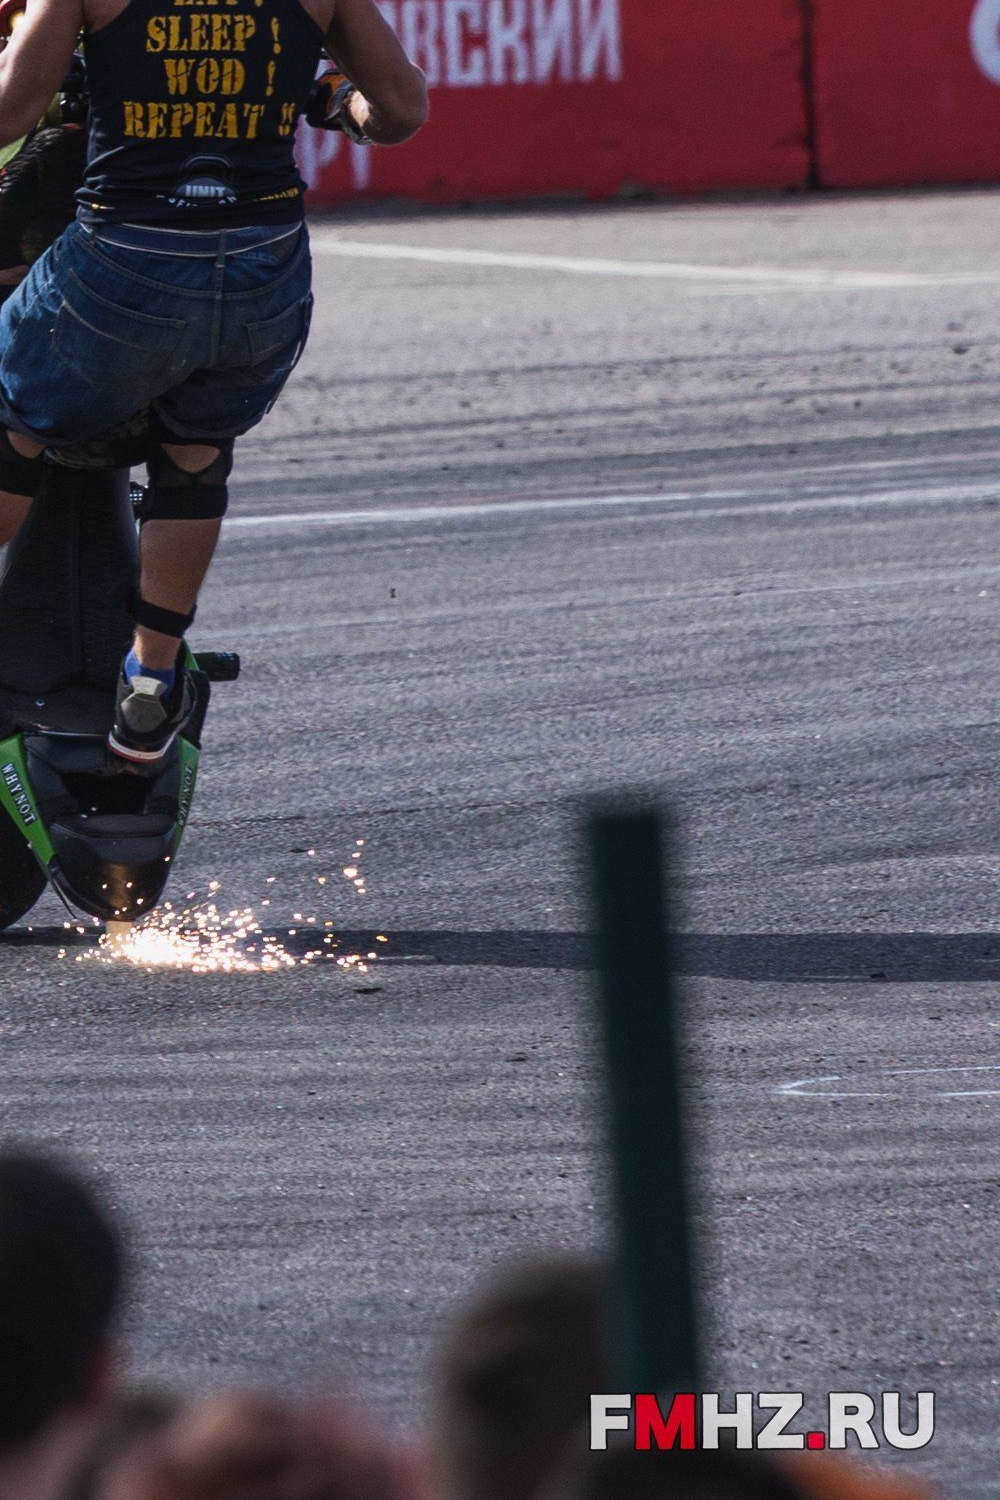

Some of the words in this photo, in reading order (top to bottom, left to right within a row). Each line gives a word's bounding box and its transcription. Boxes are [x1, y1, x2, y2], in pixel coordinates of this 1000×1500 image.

[145, 13, 257, 53] SLEEP
[162, 58, 246, 96] WOD
[122, 100, 266, 140] REPEAT
